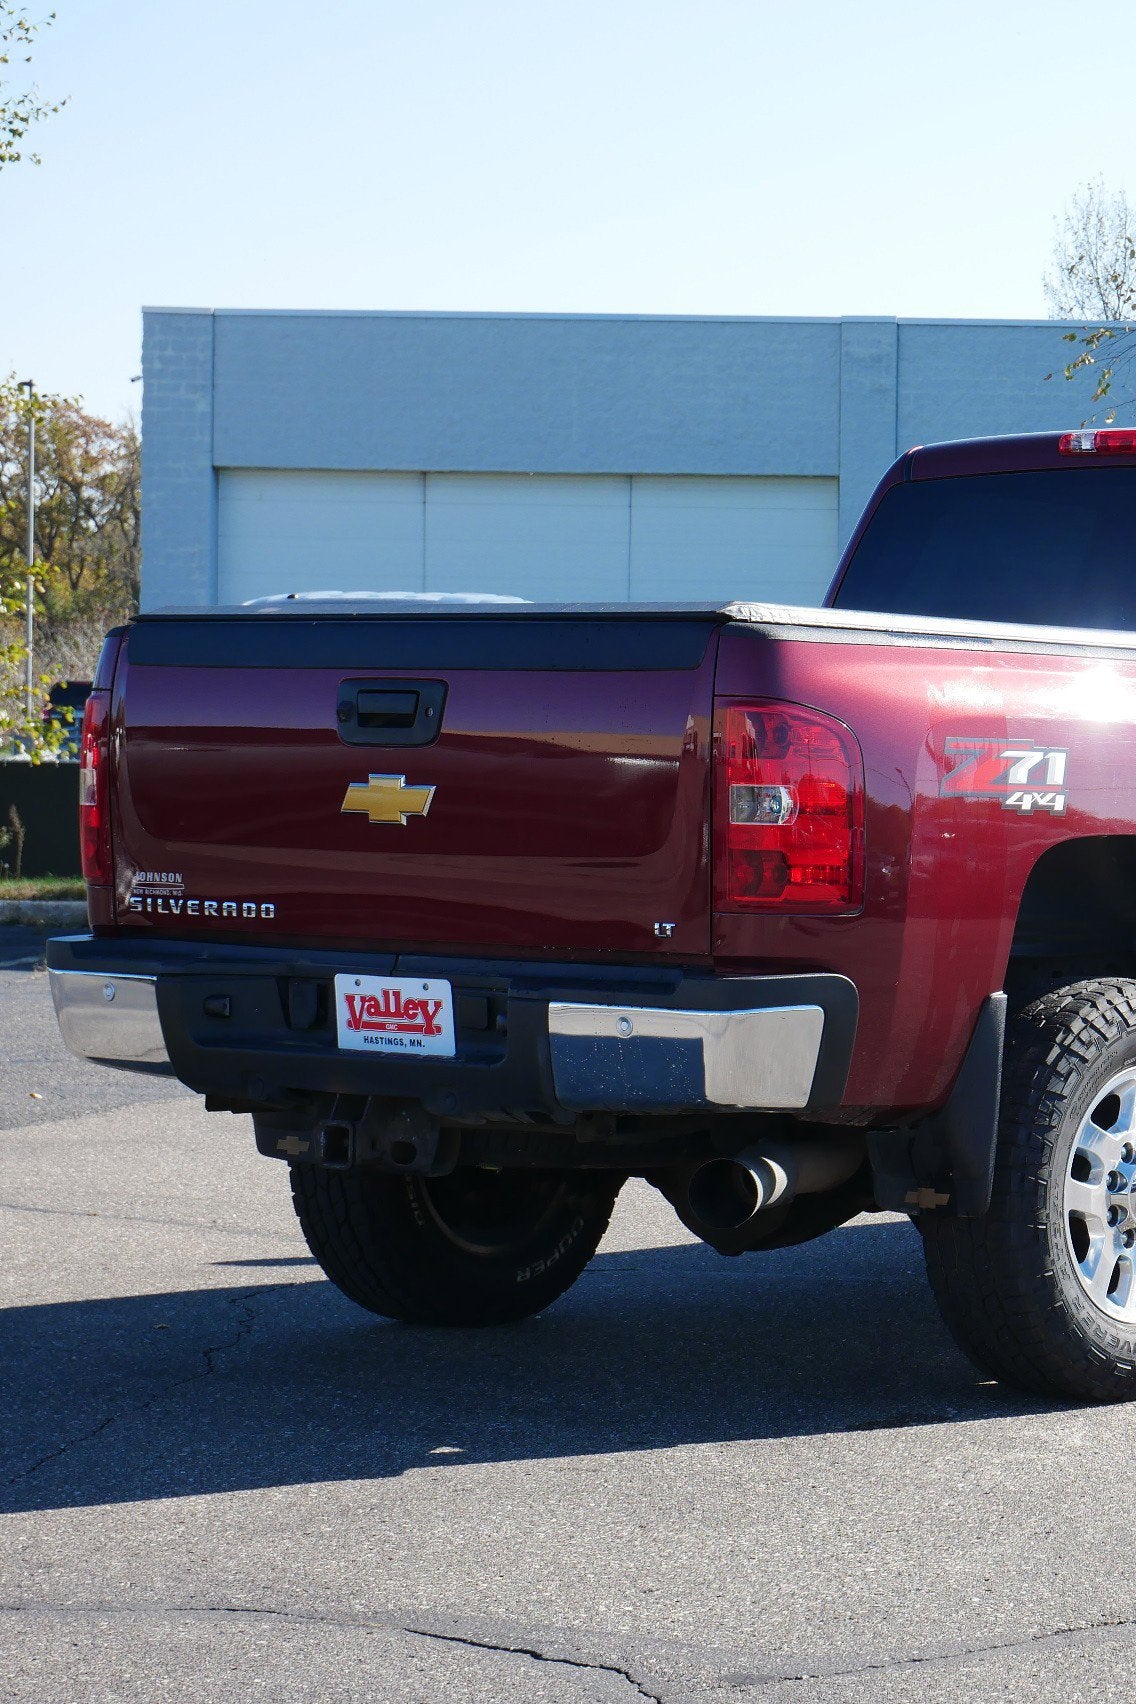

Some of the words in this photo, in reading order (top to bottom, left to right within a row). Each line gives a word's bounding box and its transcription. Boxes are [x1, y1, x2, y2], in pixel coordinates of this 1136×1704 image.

[940, 737, 1069, 798] Z71
[134, 871, 183, 883] JOHNSON
[129, 896, 275, 919] SILVERADO
[654, 922, 676, 938] LT
[344, 988, 443, 1036] Valley
[385, 1023, 398, 1031] GMC
[363, 1035, 407, 1048] HASTINGS,
[409, 1038, 426, 1048] MN.
